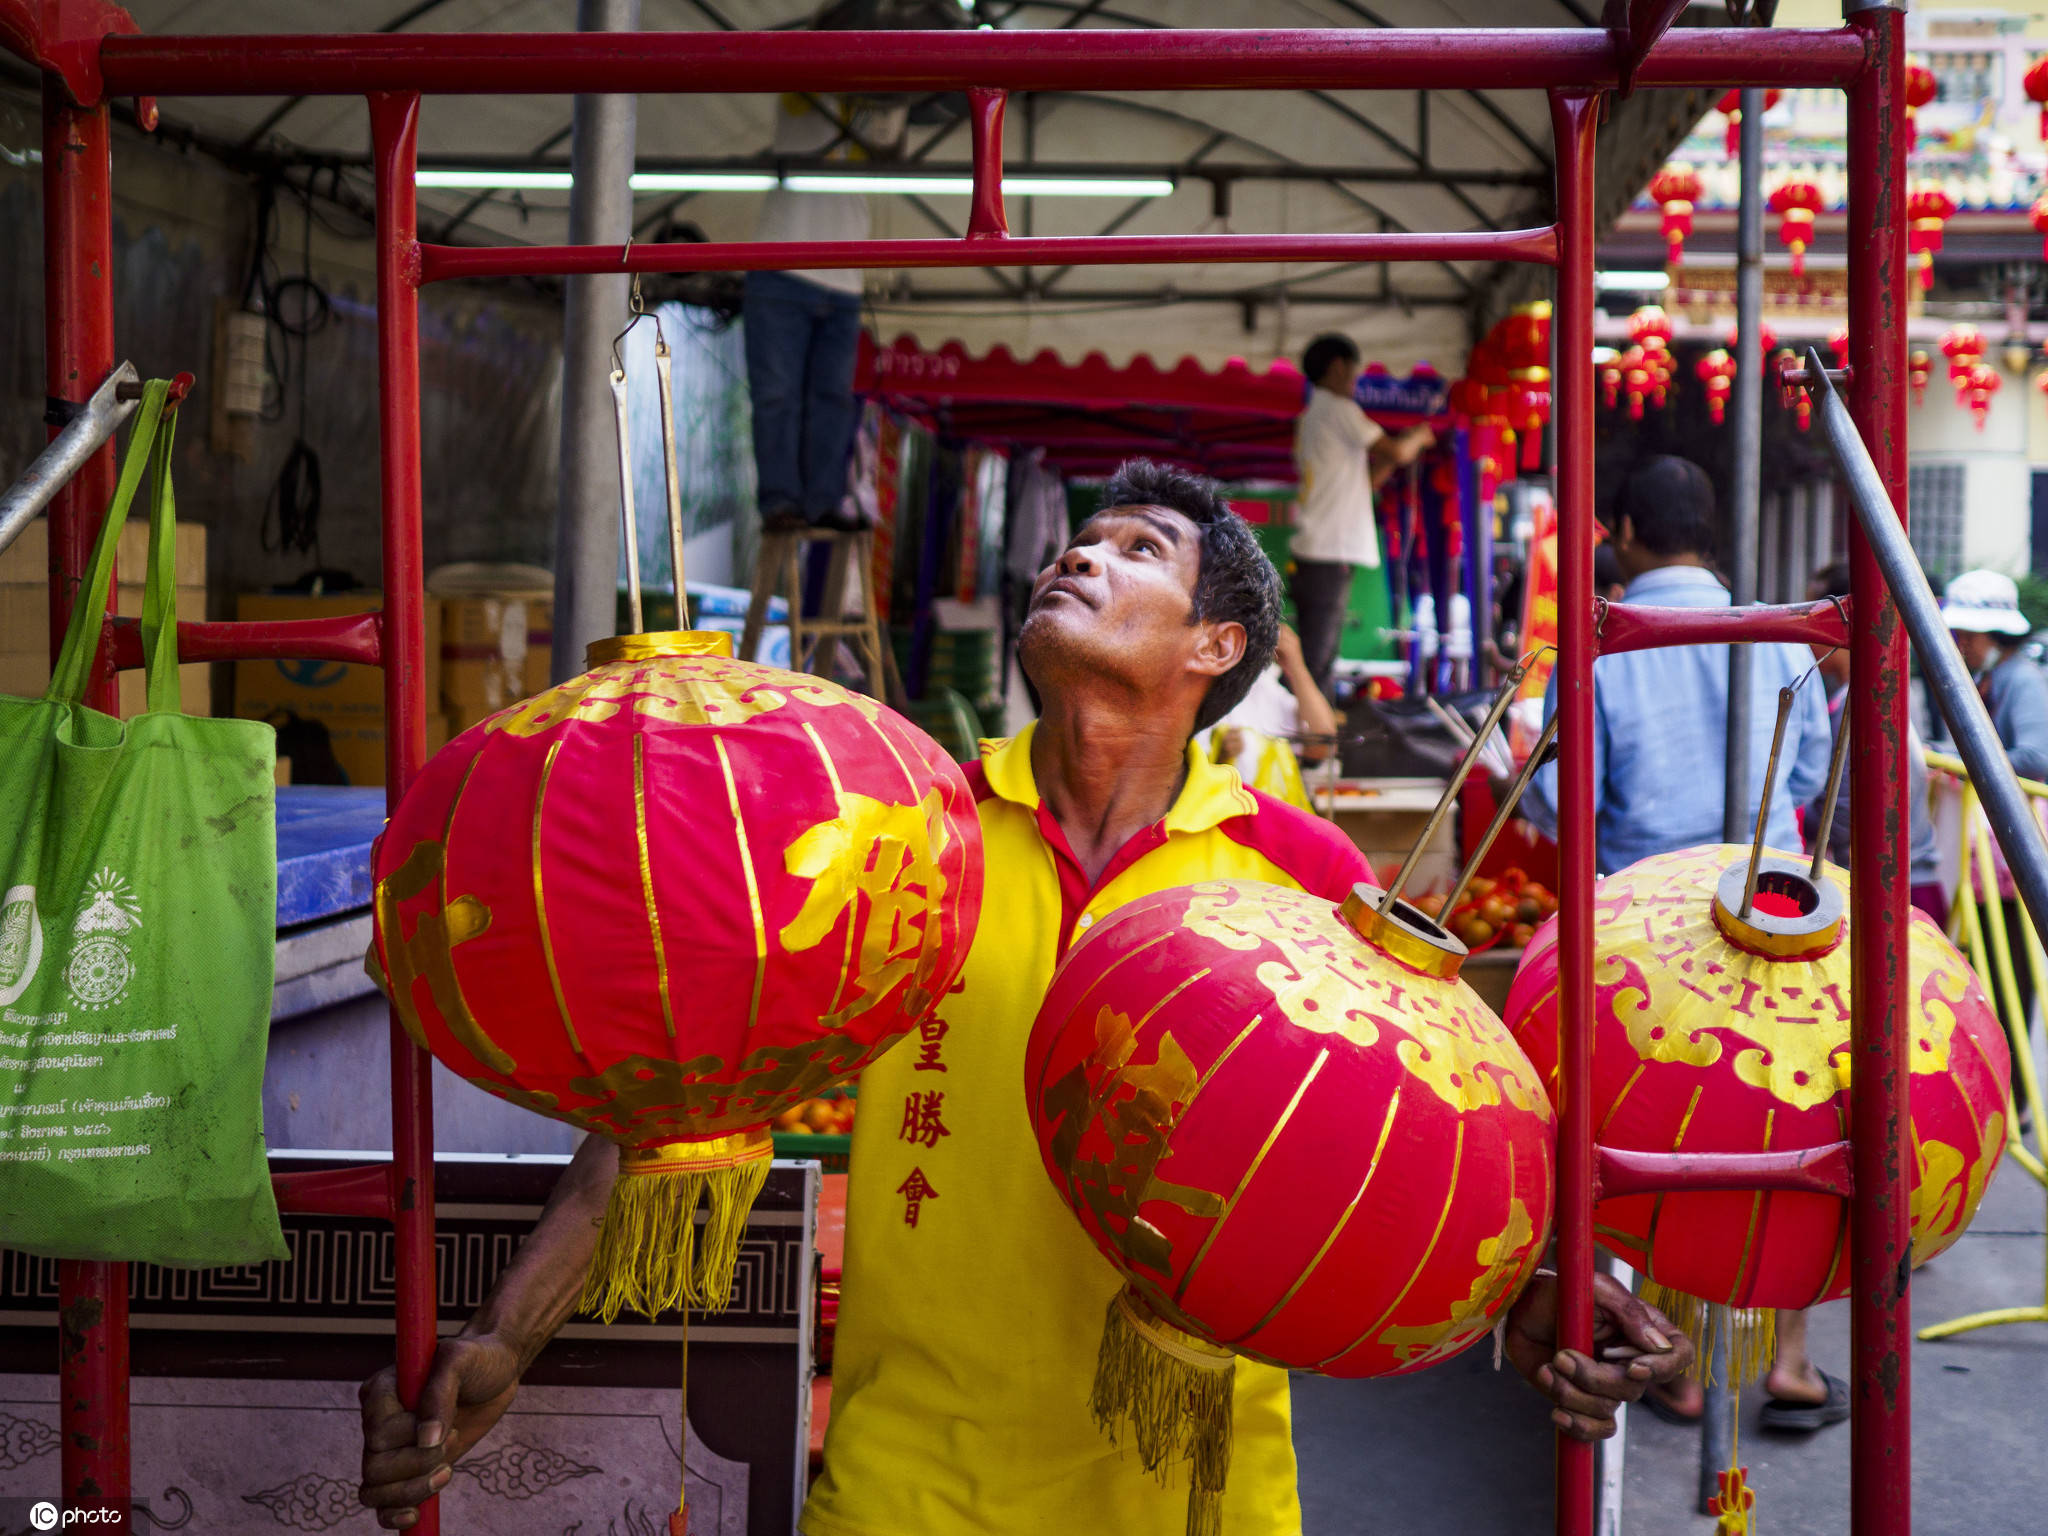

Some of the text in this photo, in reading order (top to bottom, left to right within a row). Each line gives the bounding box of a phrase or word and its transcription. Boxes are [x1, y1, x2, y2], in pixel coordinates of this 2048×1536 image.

[58, 1143, 151, 1163] กรุงเทพมหานคร
[896, 975, 965, 1229] 皇勝會
